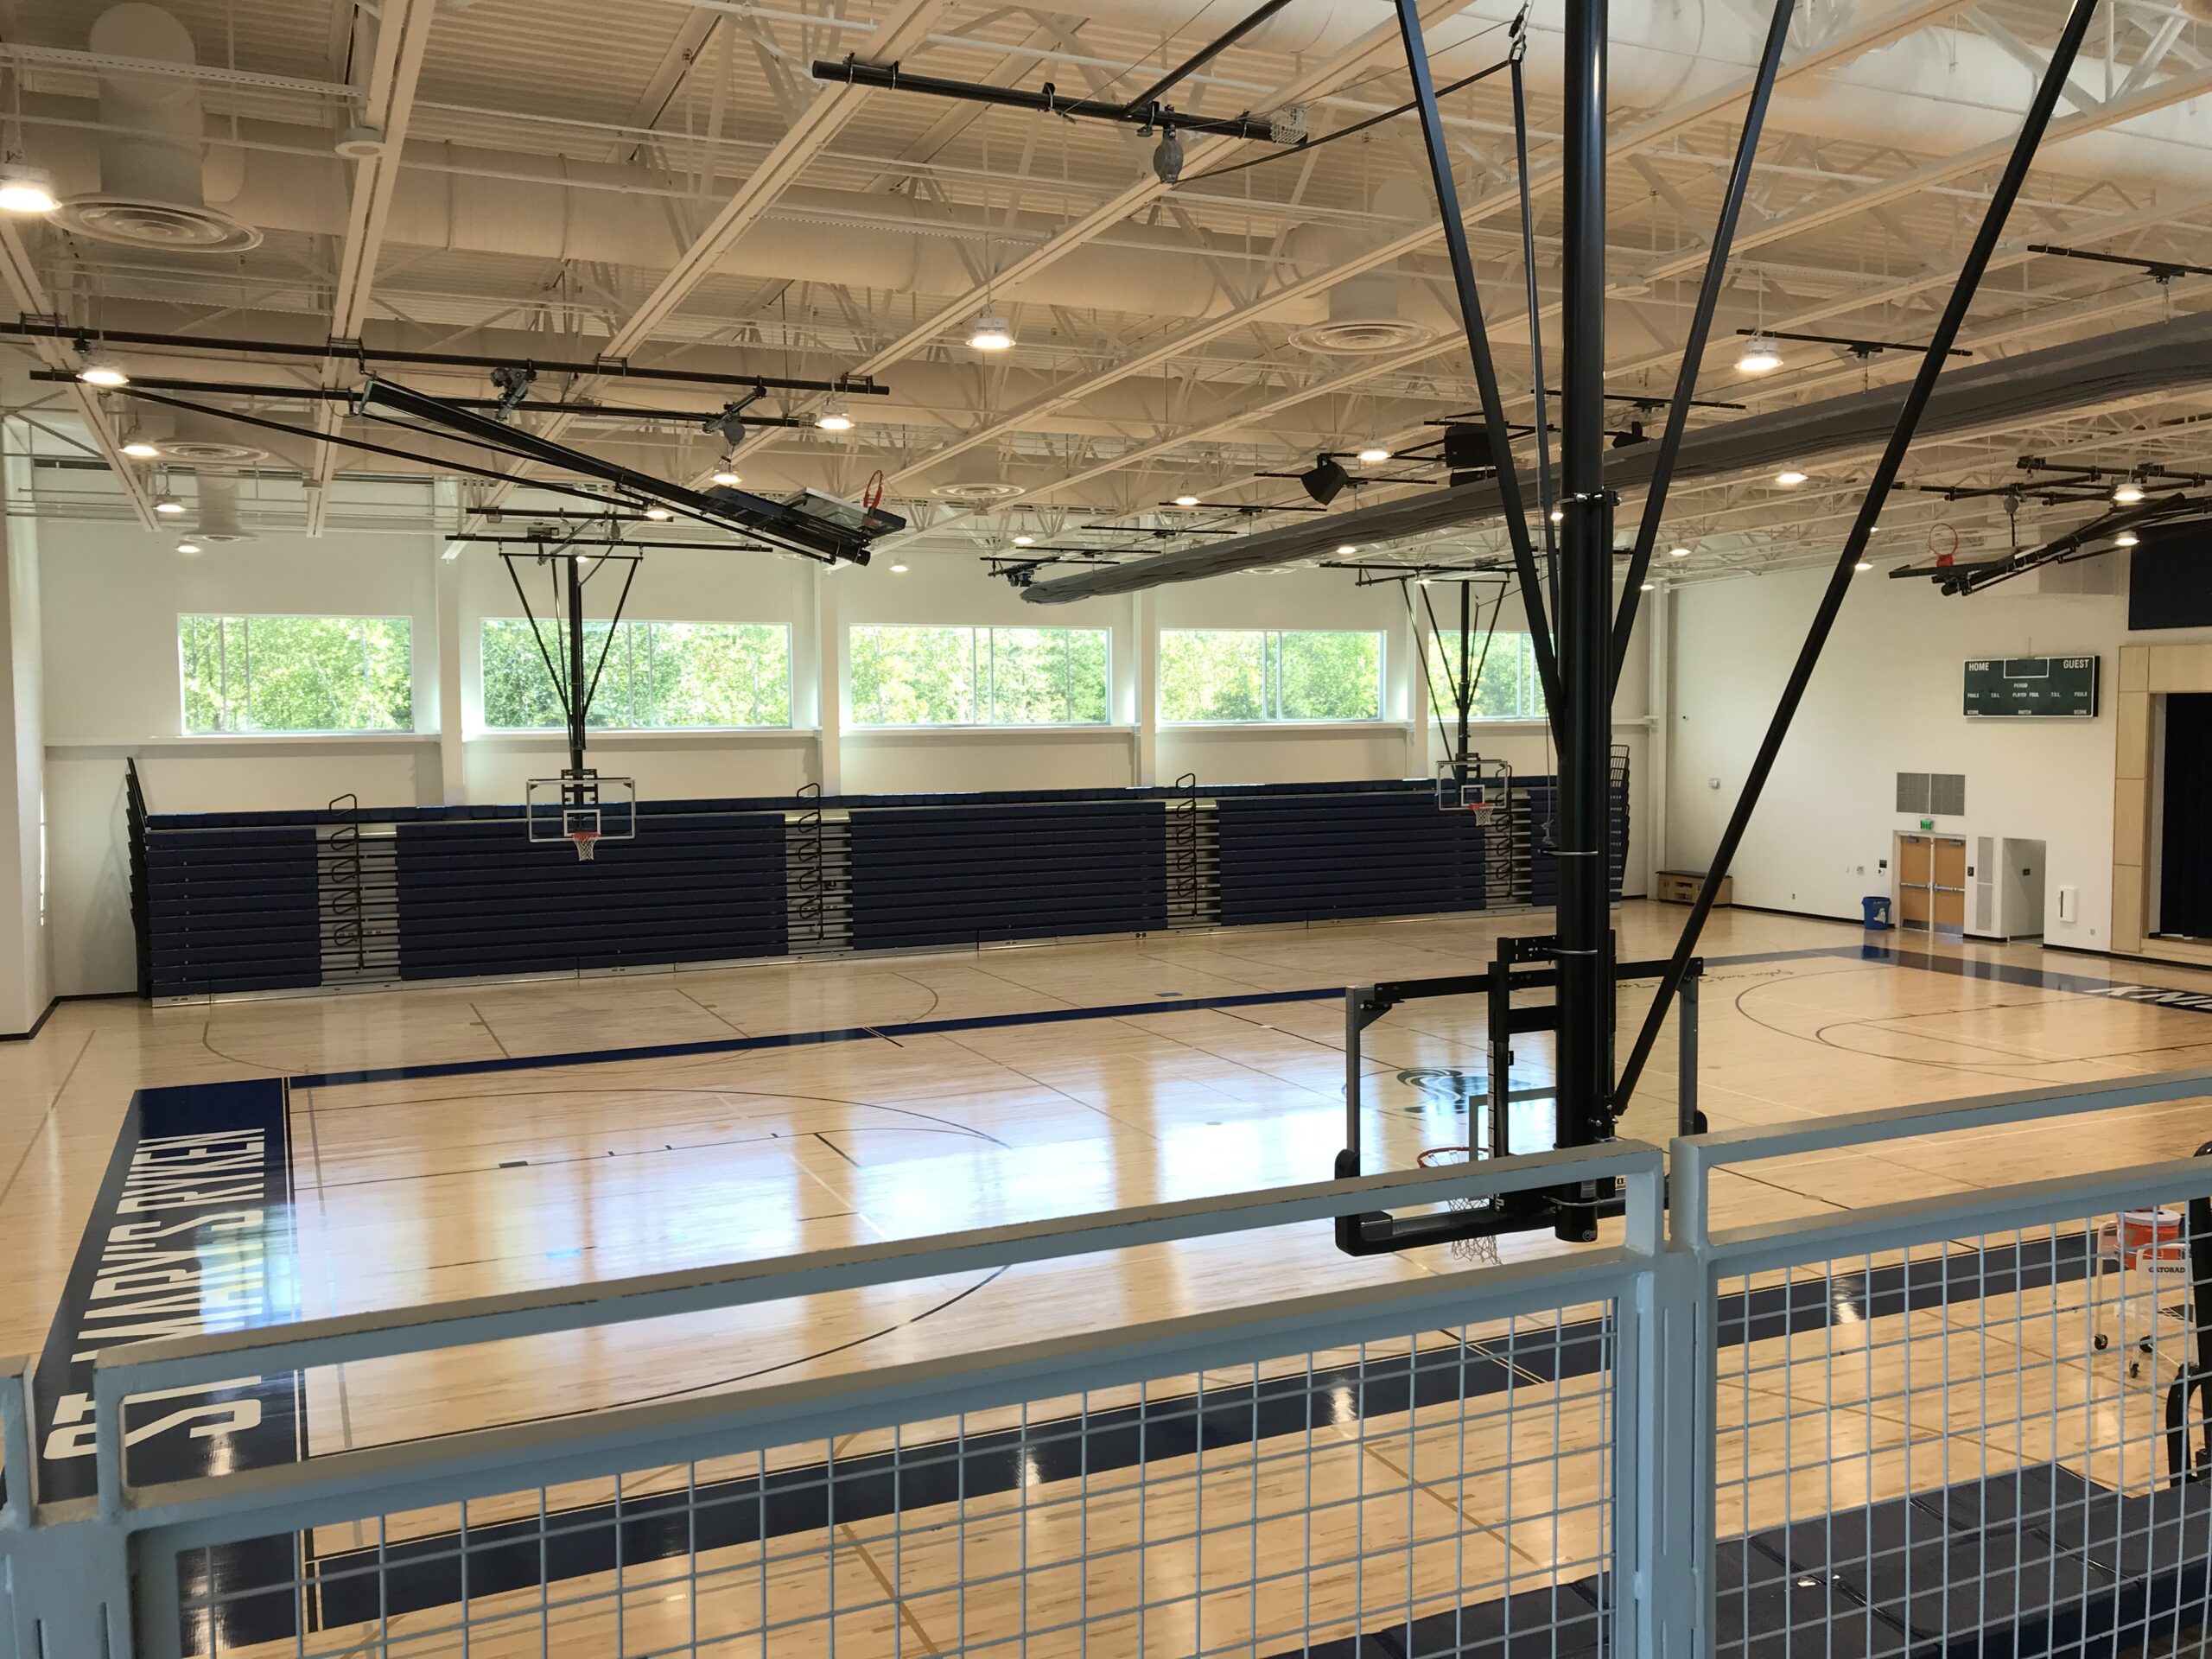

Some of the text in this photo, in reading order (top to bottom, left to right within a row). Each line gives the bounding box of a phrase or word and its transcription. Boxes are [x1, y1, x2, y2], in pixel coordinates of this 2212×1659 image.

[1968, 663, 1990, 671] HOME
[2063, 659, 2090, 669] GUEST
[116, 1128, 264, 1214] RYKEN
[72, 1210, 264, 1363] MARY'S
